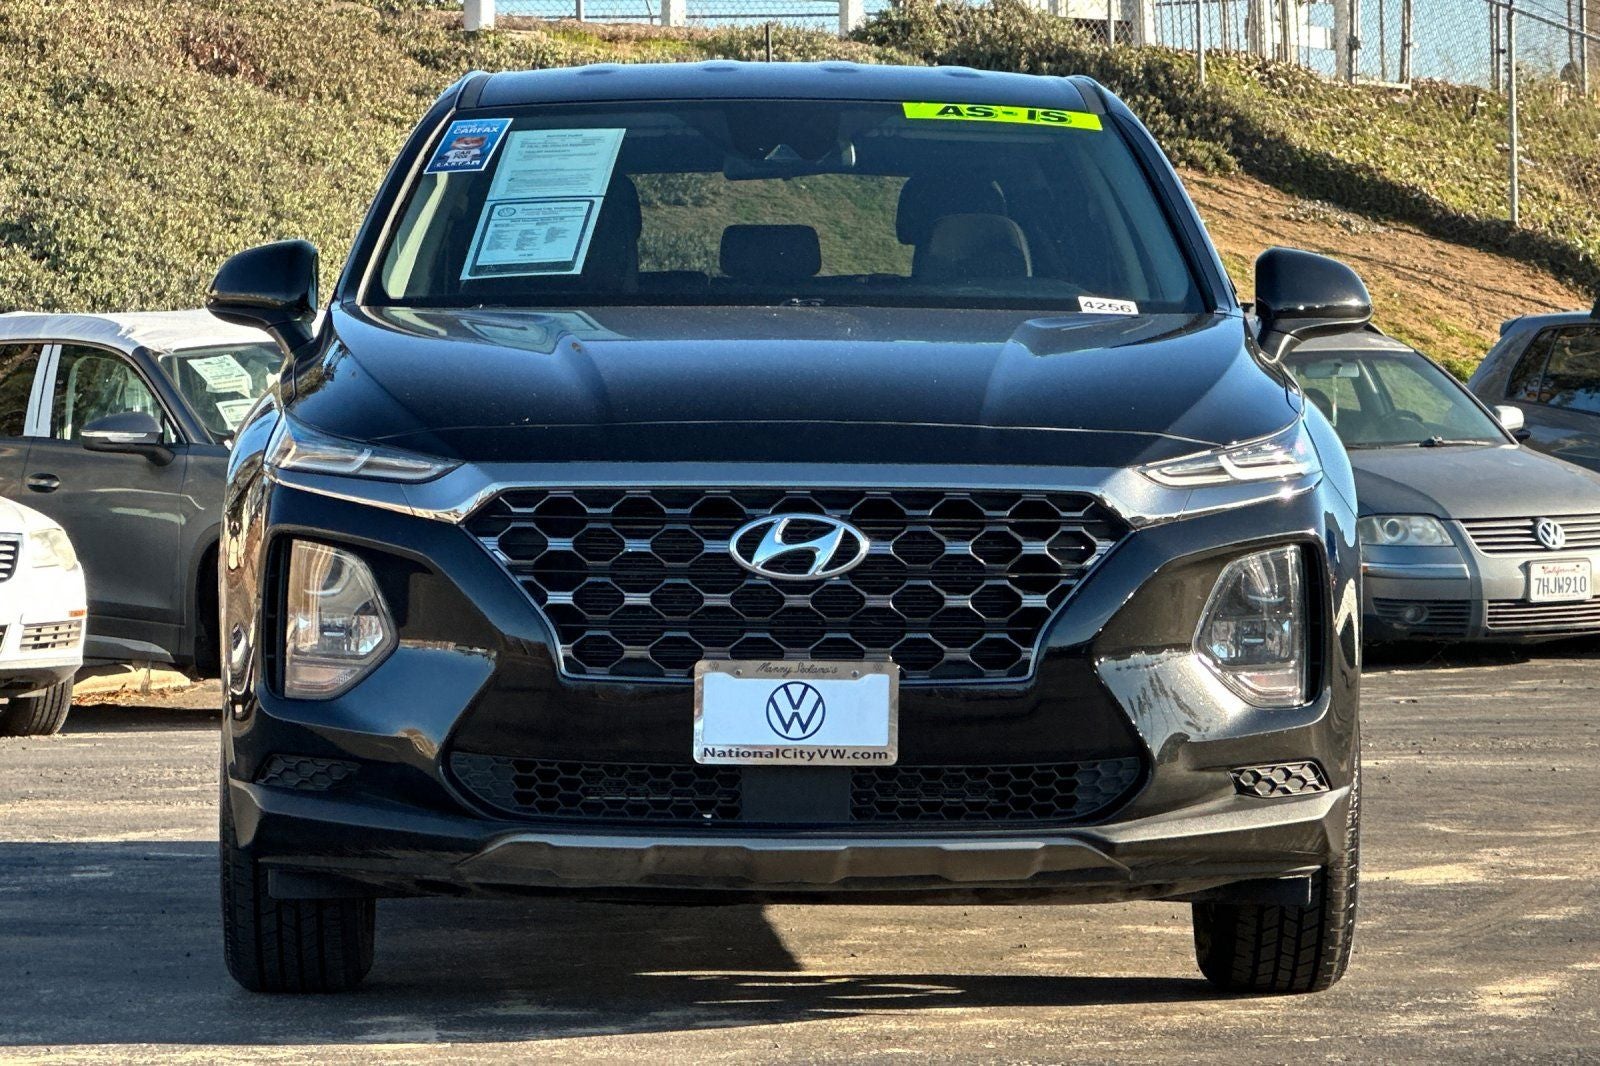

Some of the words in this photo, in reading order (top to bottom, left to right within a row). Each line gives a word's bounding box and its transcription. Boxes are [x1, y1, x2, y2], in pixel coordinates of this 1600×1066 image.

[453, 126, 499, 134] CARFAX
[1083, 301, 1132, 313] 4256
[1534, 576, 1587, 596] 7HJW910
[703, 747, 889, 762] NationalCityVW.com
